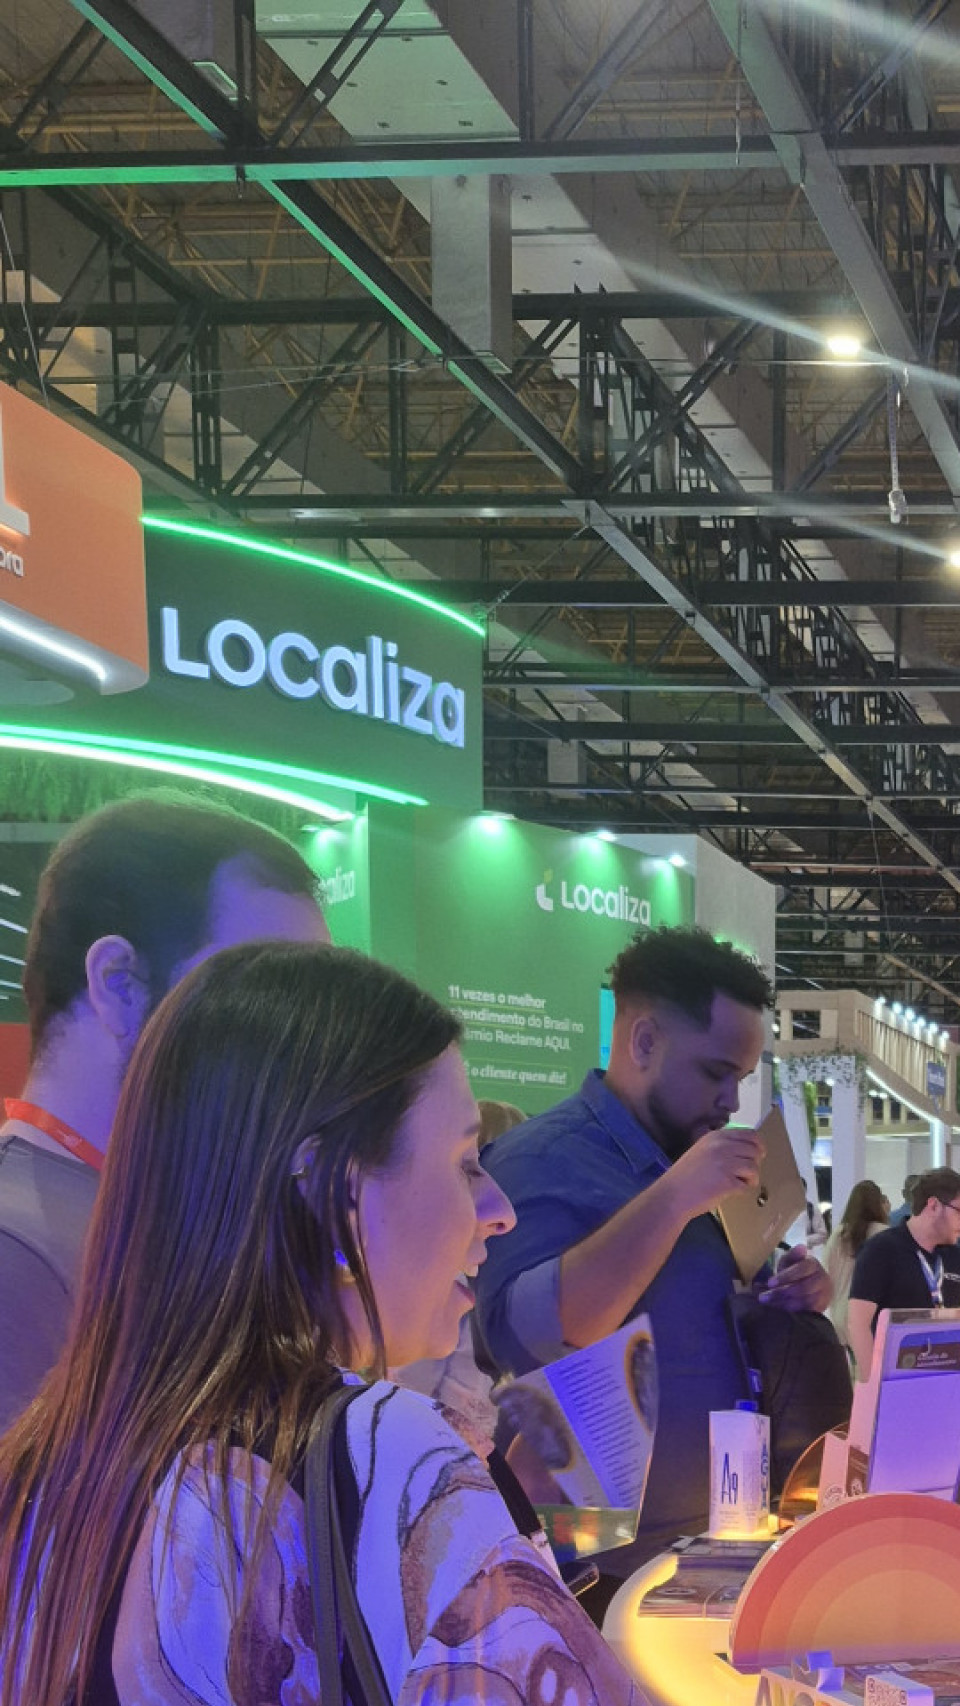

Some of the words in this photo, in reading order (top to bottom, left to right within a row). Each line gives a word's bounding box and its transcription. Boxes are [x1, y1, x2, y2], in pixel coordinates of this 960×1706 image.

[448, 984, 460, 999] 11
[462, 988, 496, 1003] vezes
[497, 993, 506, 1004] o
[508, 993, 546, 1009] melhor
[527, 1013, 542, 1028] do
[543, 1016, 570, 1032] Brasil
[571, 1021, 584, 1034] no
[496, 1028, 543, 1048] Reclame
[479, 1063, 519, 1080] cliente
[518, 1069, 547, 1084] quem
